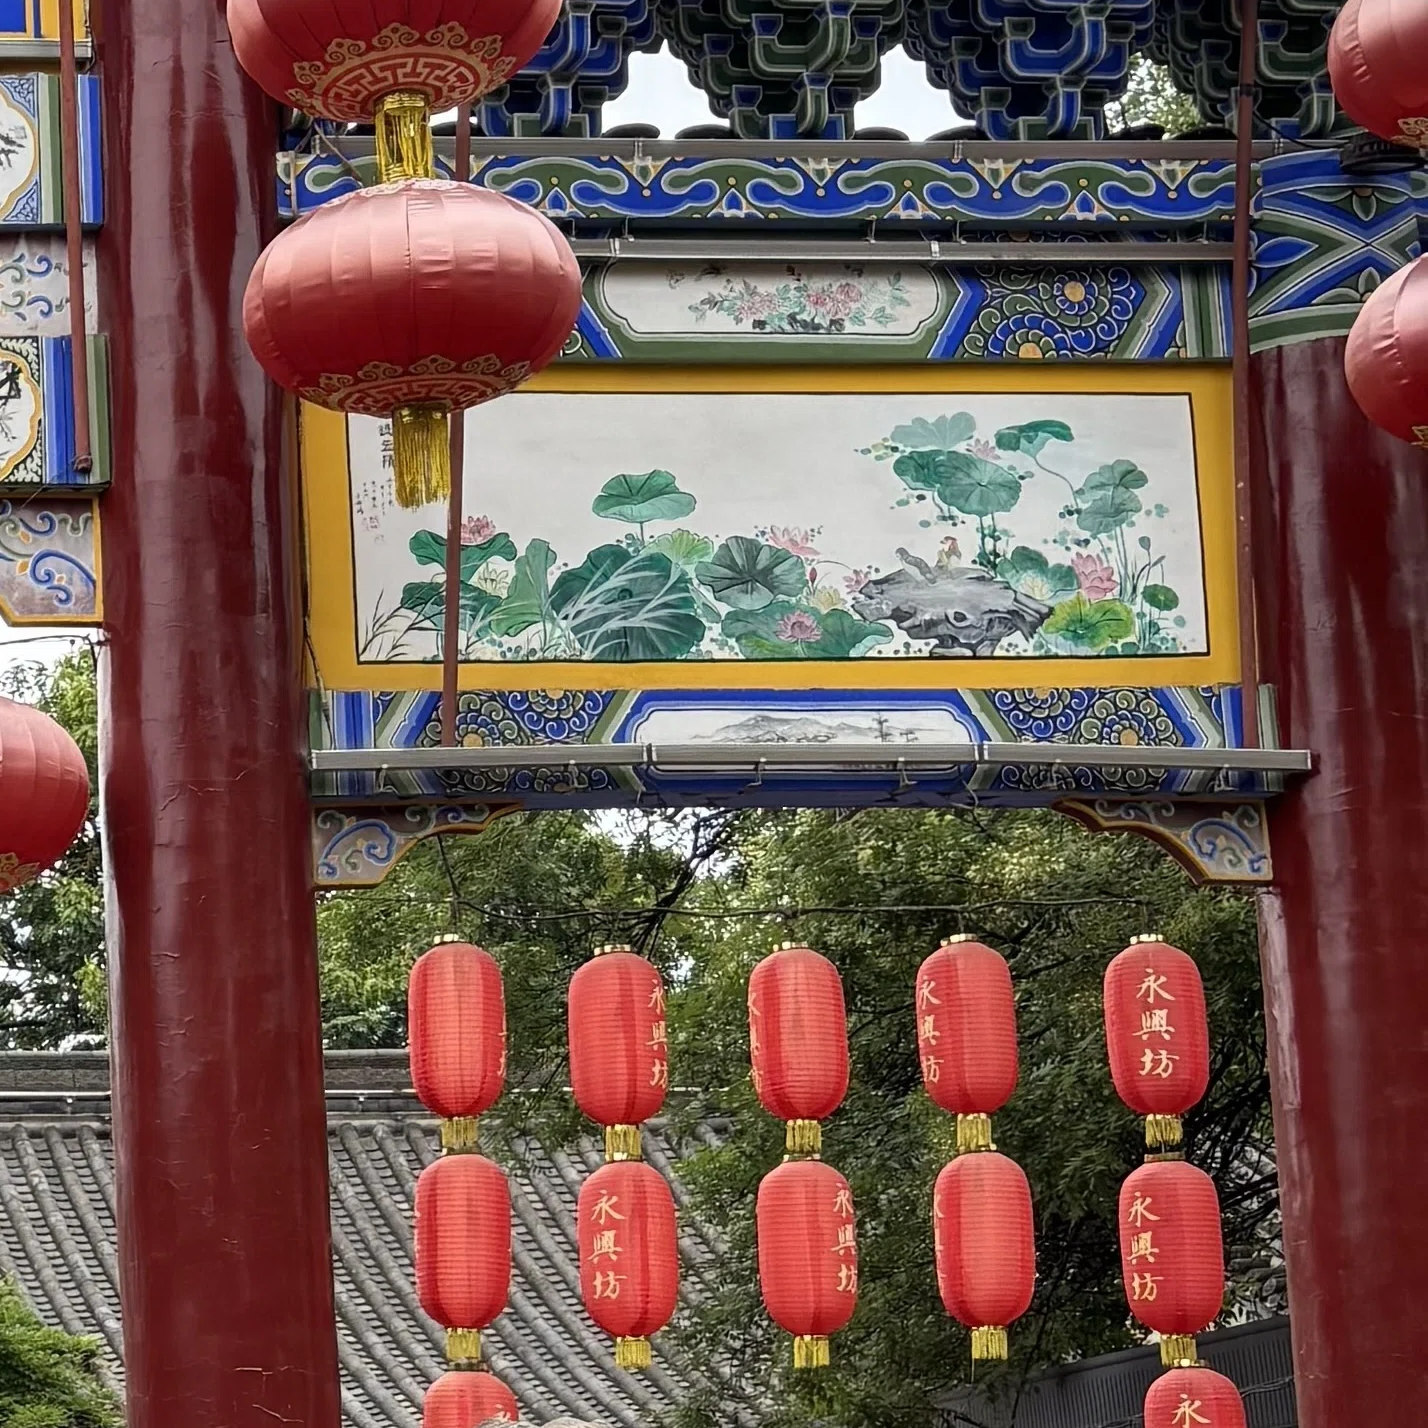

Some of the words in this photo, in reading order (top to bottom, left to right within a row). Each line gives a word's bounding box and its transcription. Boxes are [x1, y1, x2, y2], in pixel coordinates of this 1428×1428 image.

[1134, 968, 1179, 1079] 永興坊
[587, 1189, 627, 1301] 永興坊
[1126, 1191, 1164, 1303] 永興坊
